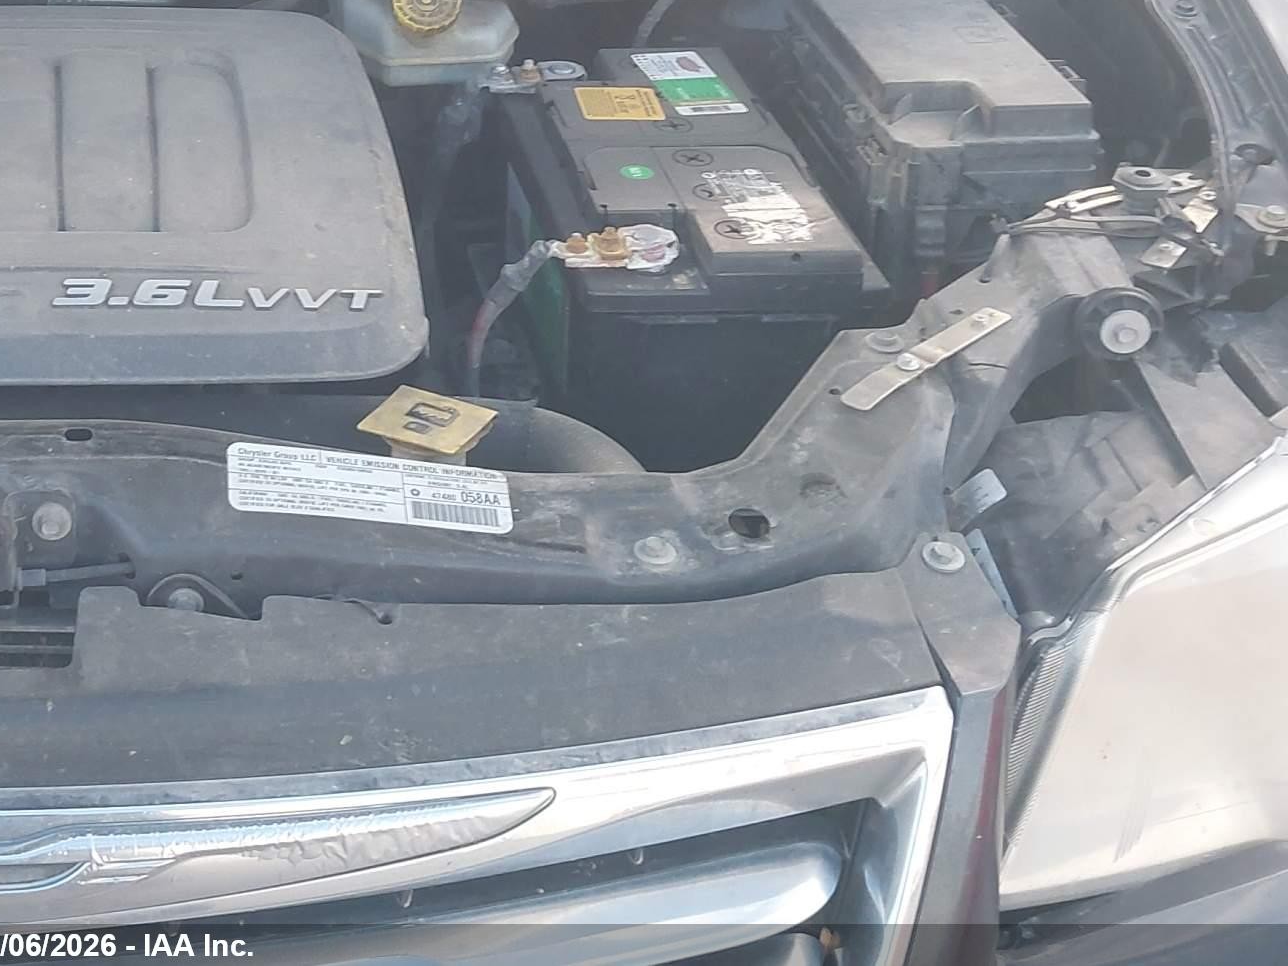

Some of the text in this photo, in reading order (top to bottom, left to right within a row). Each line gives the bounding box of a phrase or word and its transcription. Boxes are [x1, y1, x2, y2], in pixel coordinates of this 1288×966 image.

[52, 278, 385, 312] 3.6L VVT
[237, 447, 318, 462] Chrysler Group LLC
[326, 456, 359, 466] VEHICLE
[361, 459, 400, 471] EMISSION
[402, 464, 440, 475] CONTROL
[441, 467, 498, 480] INFORMATION
